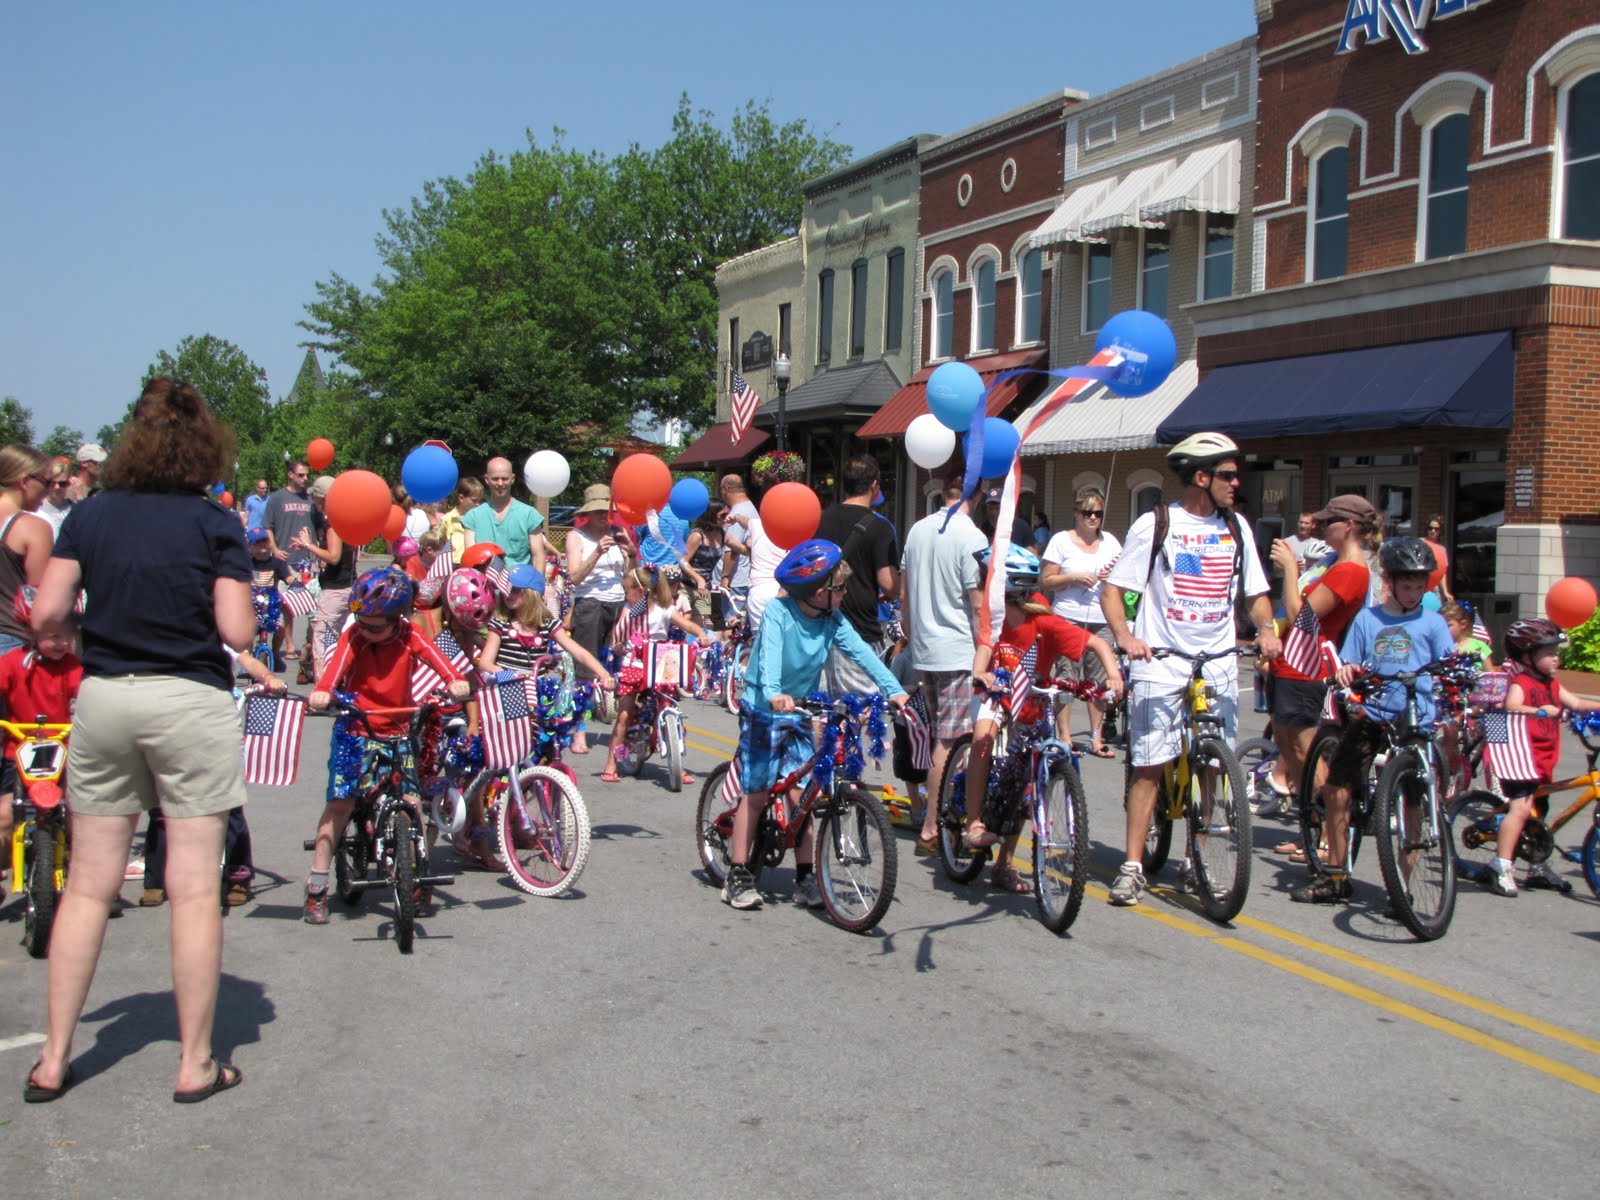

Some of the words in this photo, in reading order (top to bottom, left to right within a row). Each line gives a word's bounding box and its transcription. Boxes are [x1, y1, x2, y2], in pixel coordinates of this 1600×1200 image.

[1263, 490, 1284, 502] ATM
[1173, 541, 1188, 550] THE
[1167, 598, 1227, 608] INTERNATIO
[25, 744, 60, 774] 1
